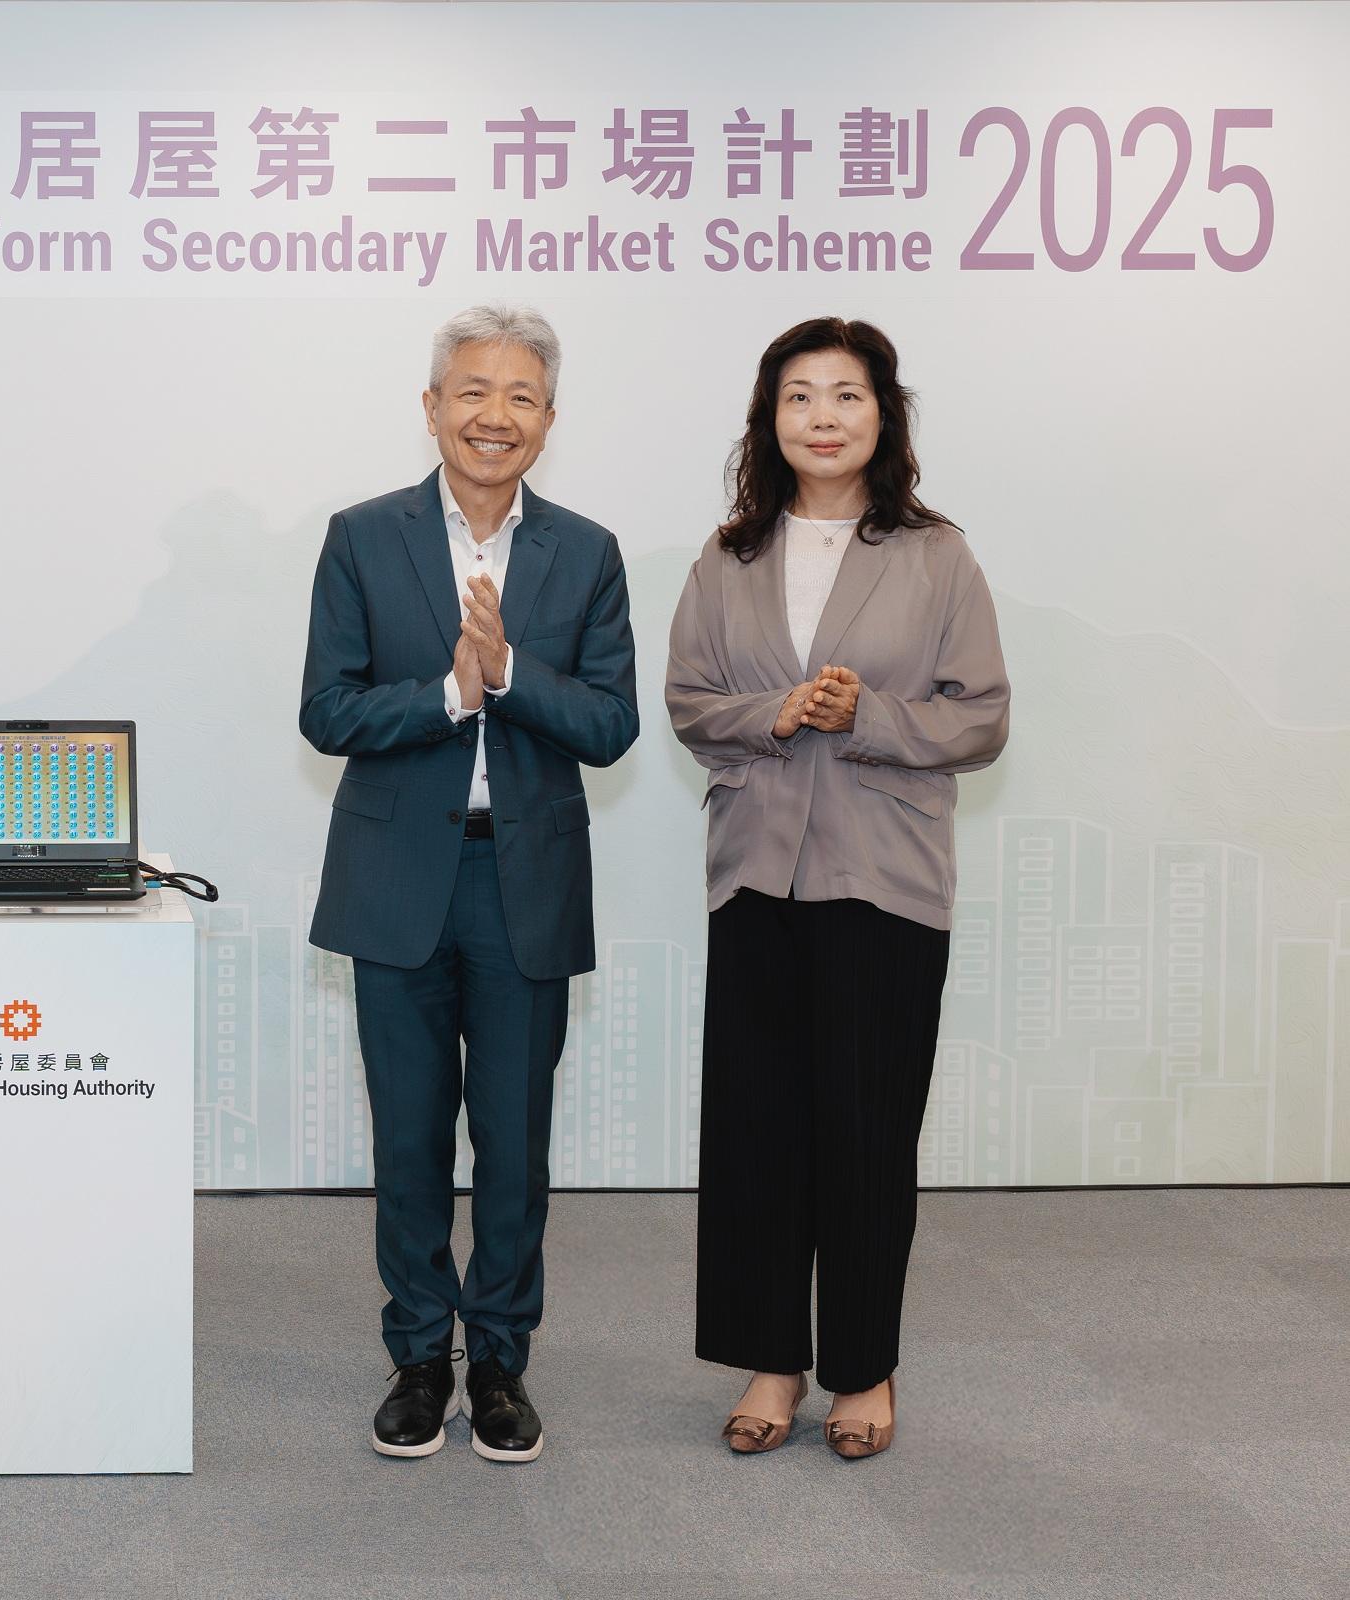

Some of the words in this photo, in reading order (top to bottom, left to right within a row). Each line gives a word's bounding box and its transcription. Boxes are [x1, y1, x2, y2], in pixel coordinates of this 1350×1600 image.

[959, 106, 1275, 273] 2025
[141, 214, 447, 288] Secondary
[476, 214, 675, 273] Market
[703, 214, 933, 273] Scheme
[72, 1078, 156, 1099] Authority
